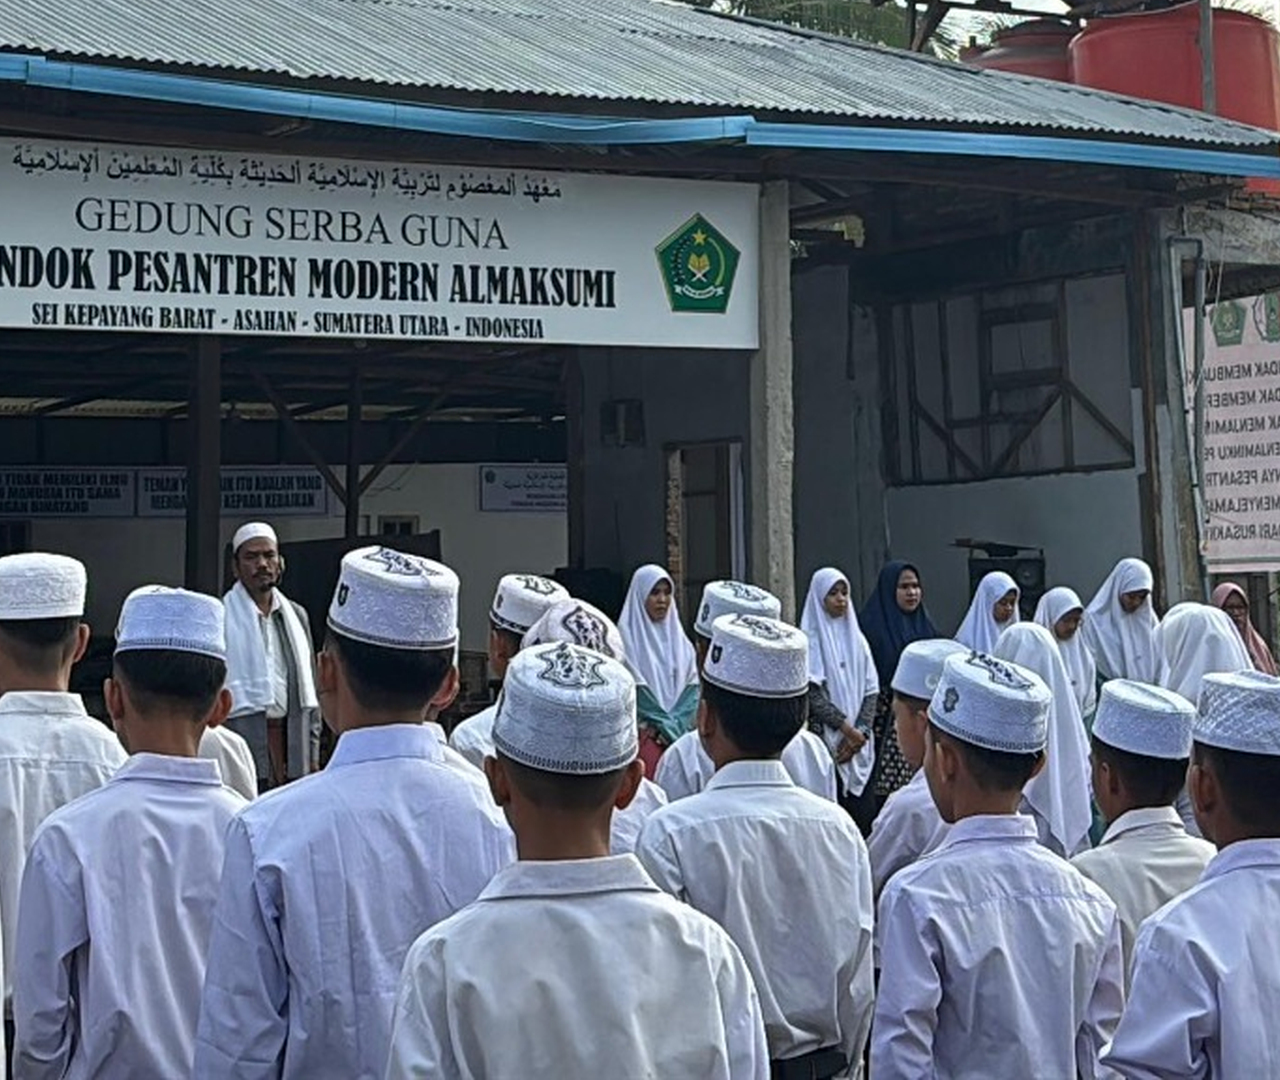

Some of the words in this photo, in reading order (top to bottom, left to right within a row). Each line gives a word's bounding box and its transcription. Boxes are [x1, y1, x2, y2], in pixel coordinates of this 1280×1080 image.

[75, 197, 253, 238] GEDUNG
[266, 207, 392, 244] SERBA
[401, 214, 509, 249] GUNA
[107, 248, 297, 297] PESANTREN
[308, 257, 439, 303] MODERN
[449, 263, 617, 308] ALMAKSUMI
[32, 302, 59, 325] SEI
[65, 304, 153, 328] KEPAYANG
[159, 307, 216, 330] BARAT
[233, 308, 297, 333] ASAHAN
[314, 311, 395, 336] SUMATERA
[400, 315, 449, 337] UTARA
[465, 316, 544, 339] INDONESIA
